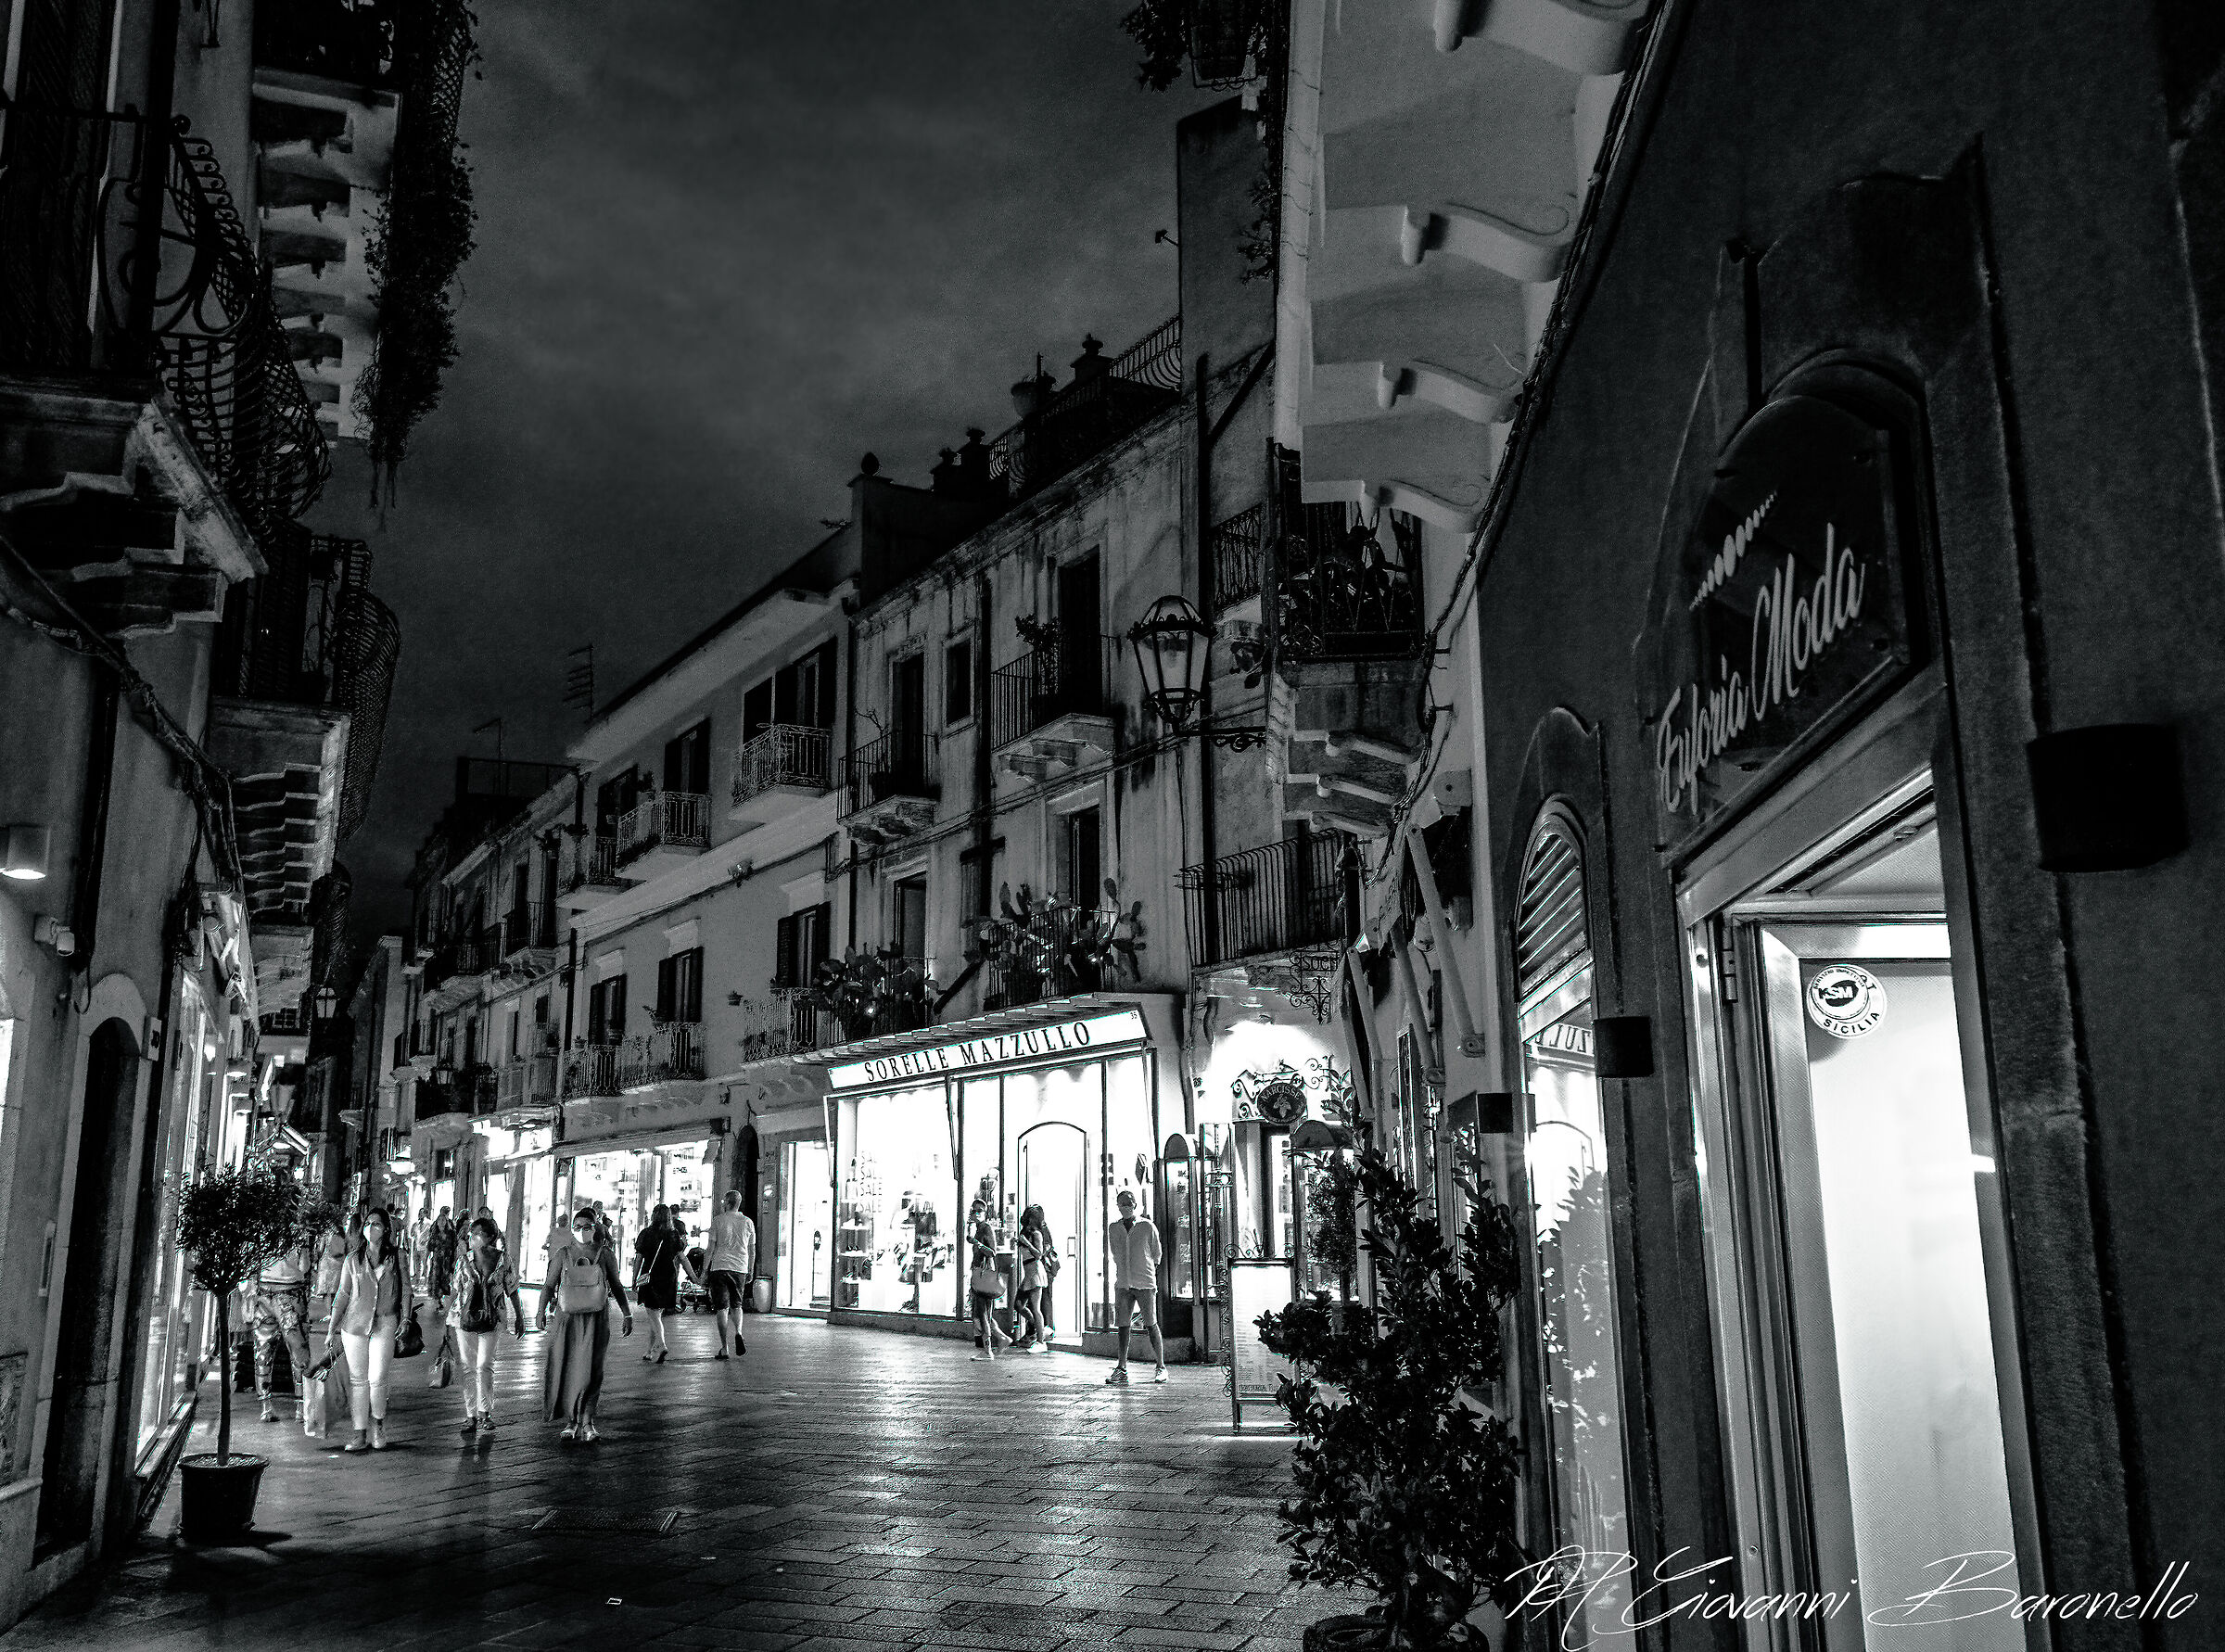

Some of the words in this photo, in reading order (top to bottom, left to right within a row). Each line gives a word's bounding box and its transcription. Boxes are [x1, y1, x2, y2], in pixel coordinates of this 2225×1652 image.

[1751, 522, 1866, 721] Moda
[864, 1048, 949, 1082] SORELLE
[958, 1022, 1090, 1065] MAZZULLO
[1823, 1012, 1880, 1034] SICILIA
